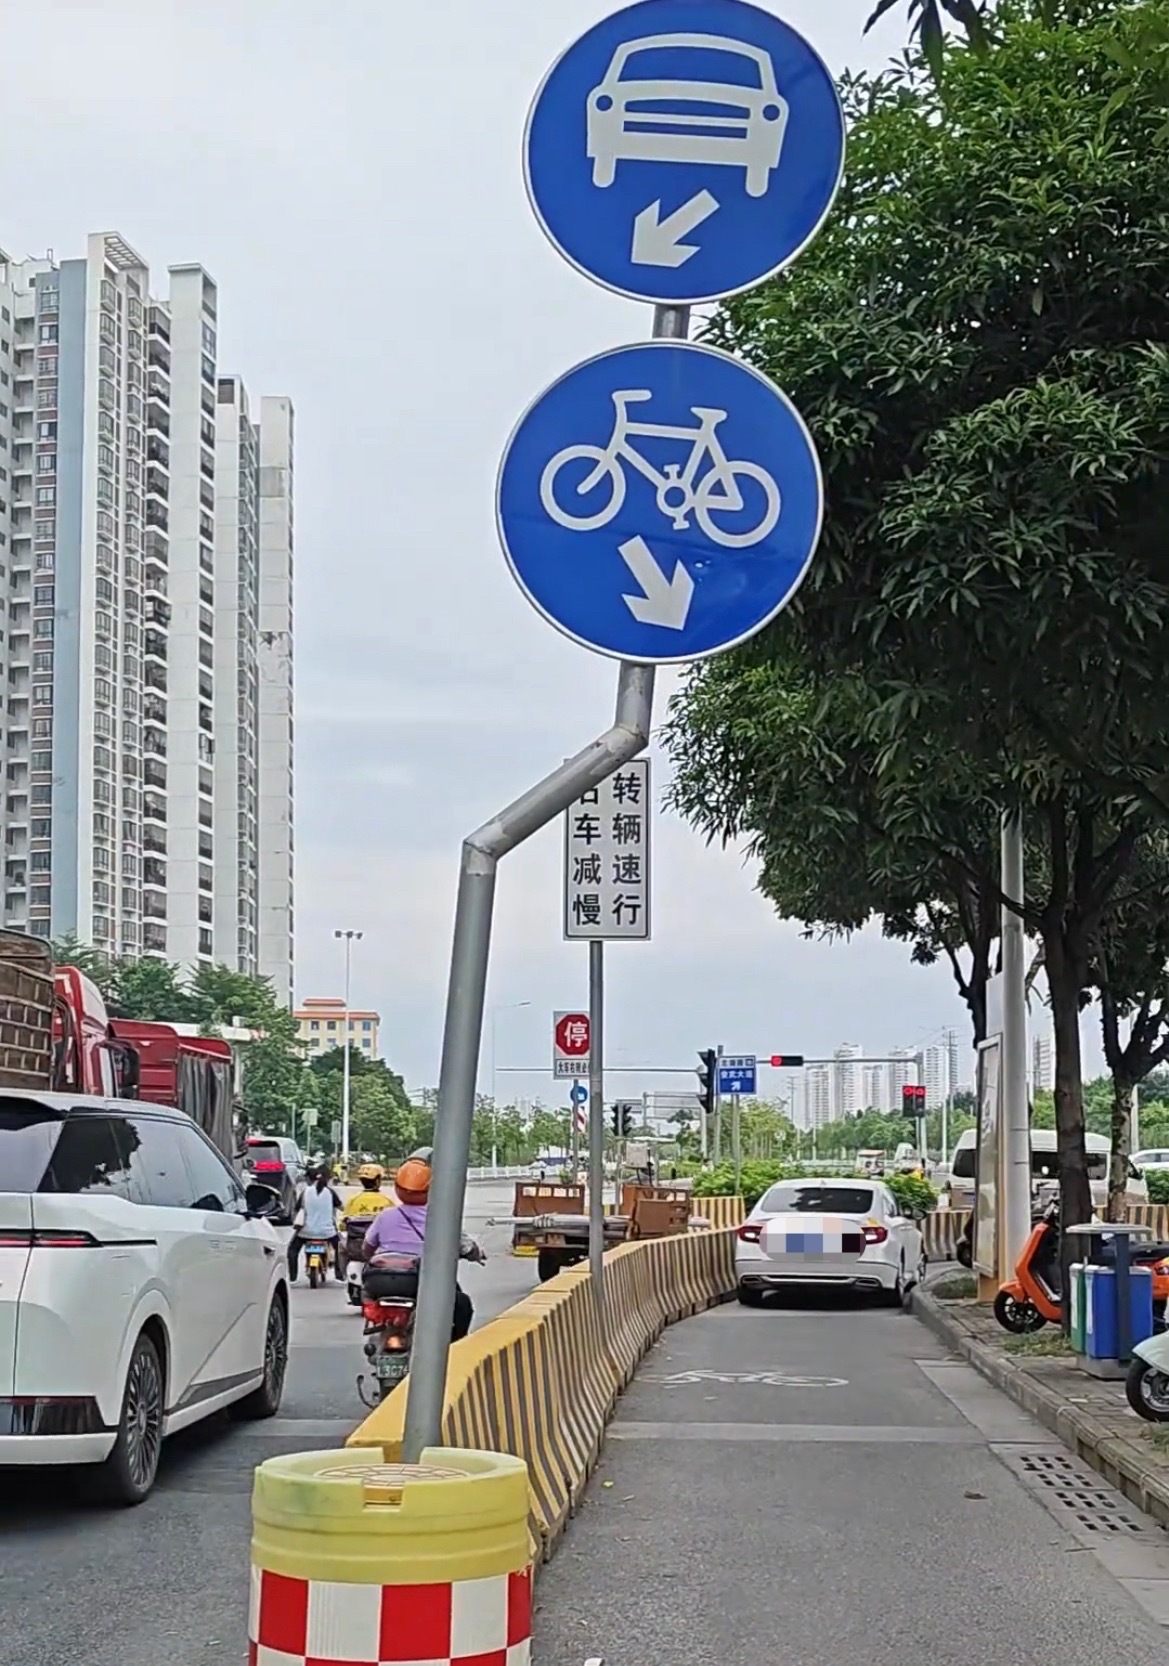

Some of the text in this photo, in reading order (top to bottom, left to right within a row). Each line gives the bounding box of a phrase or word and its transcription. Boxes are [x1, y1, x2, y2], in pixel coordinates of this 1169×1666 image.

[573, 813, 642, 845] 车辆
[572, 853, 642, 885] 减速
[572, 893, 642, 926] 慢行
[564, 1021, 588, 1047] 停
